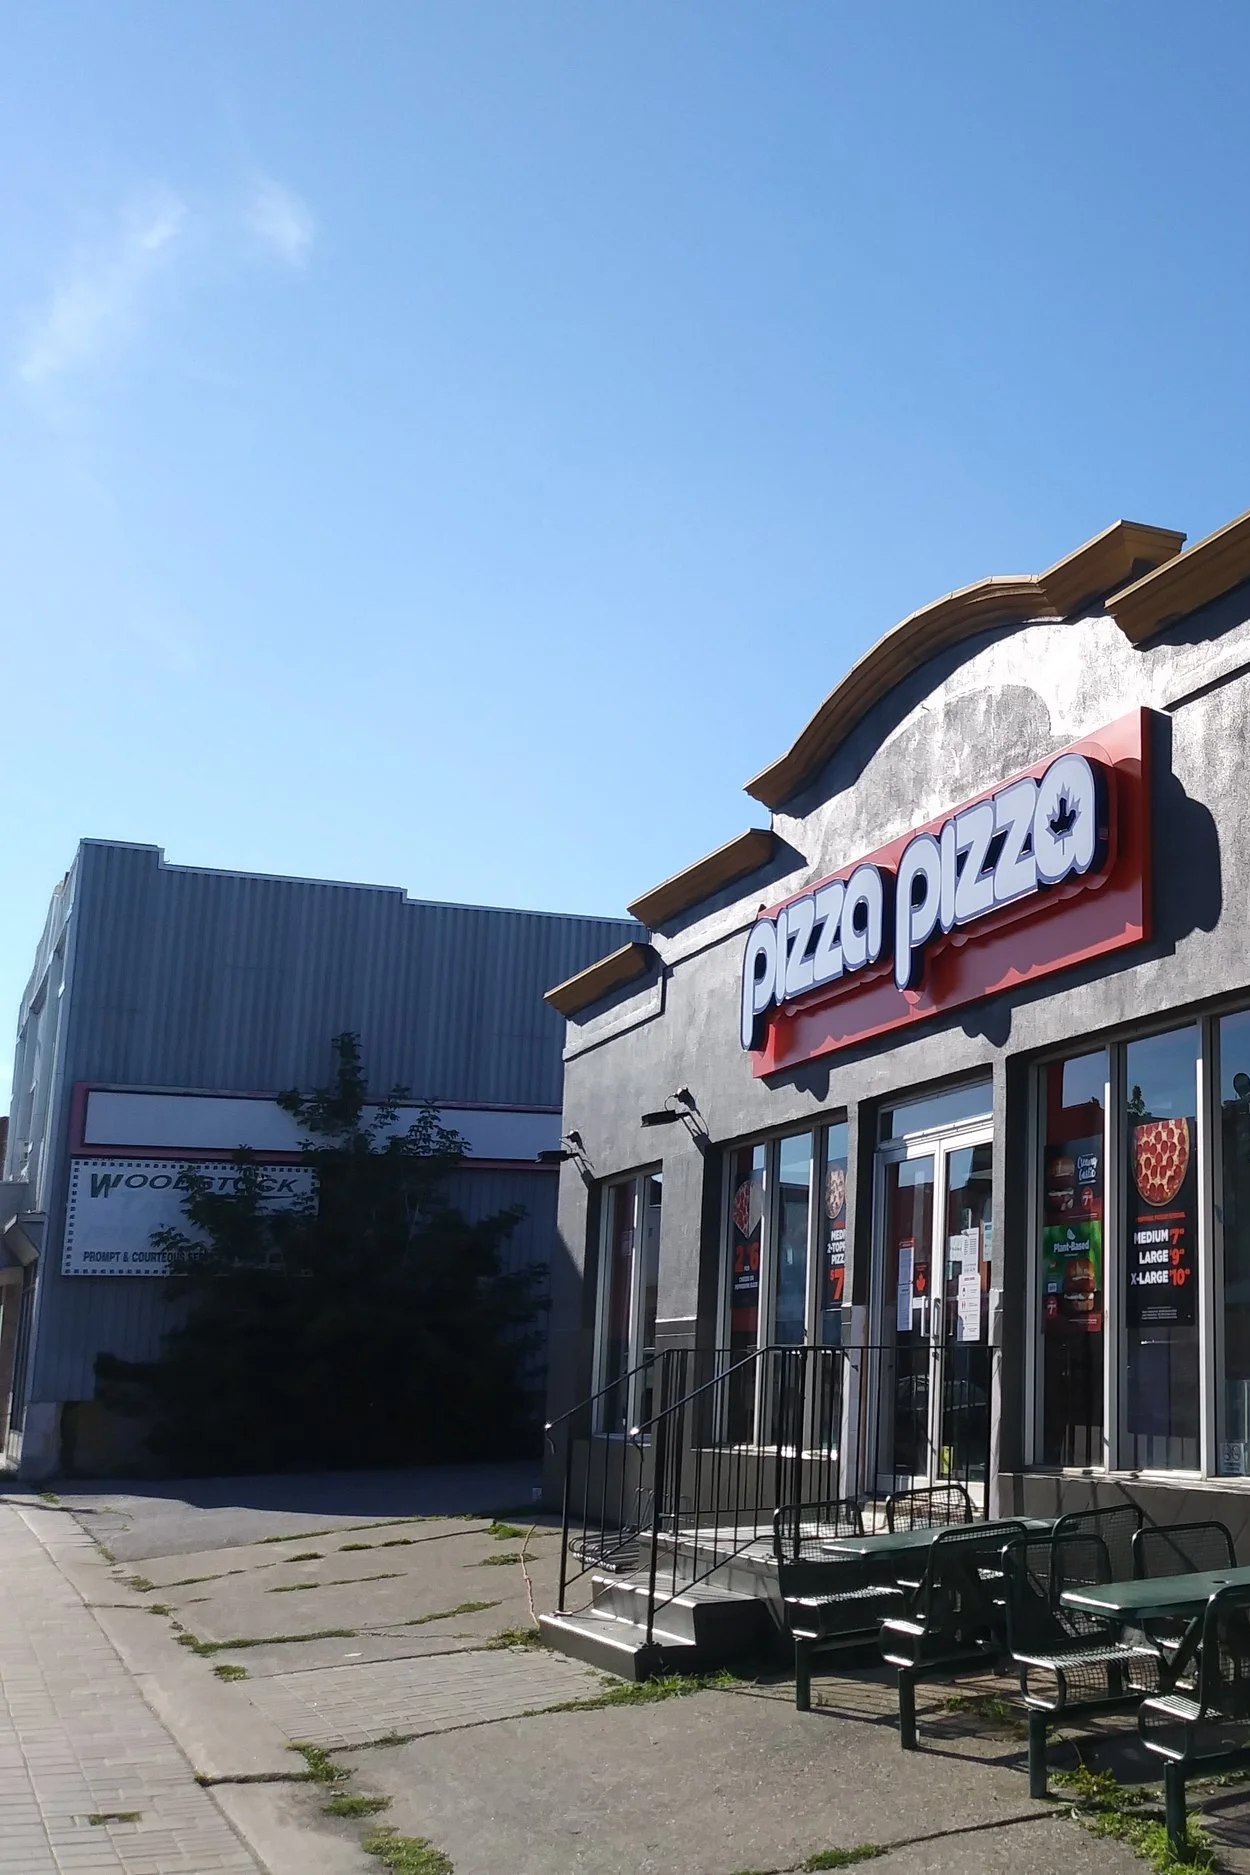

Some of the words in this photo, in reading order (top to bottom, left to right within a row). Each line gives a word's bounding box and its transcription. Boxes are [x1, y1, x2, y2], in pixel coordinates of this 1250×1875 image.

[740, 863, 884, 1052] pizza
[895, 752, 1096, 992] pizza
[1134, 1228, 1169, 1245] MEDIUM
[1053, 1239, 1090, 1253] Plant-Based
[83, 1251, 122, 1263] PROMPT
[123, 1251, 129, 1262] &
[1139, 1249, 1169, 1265] LARGE
[1130, 1269, 1169, 1286] X-LARGE
